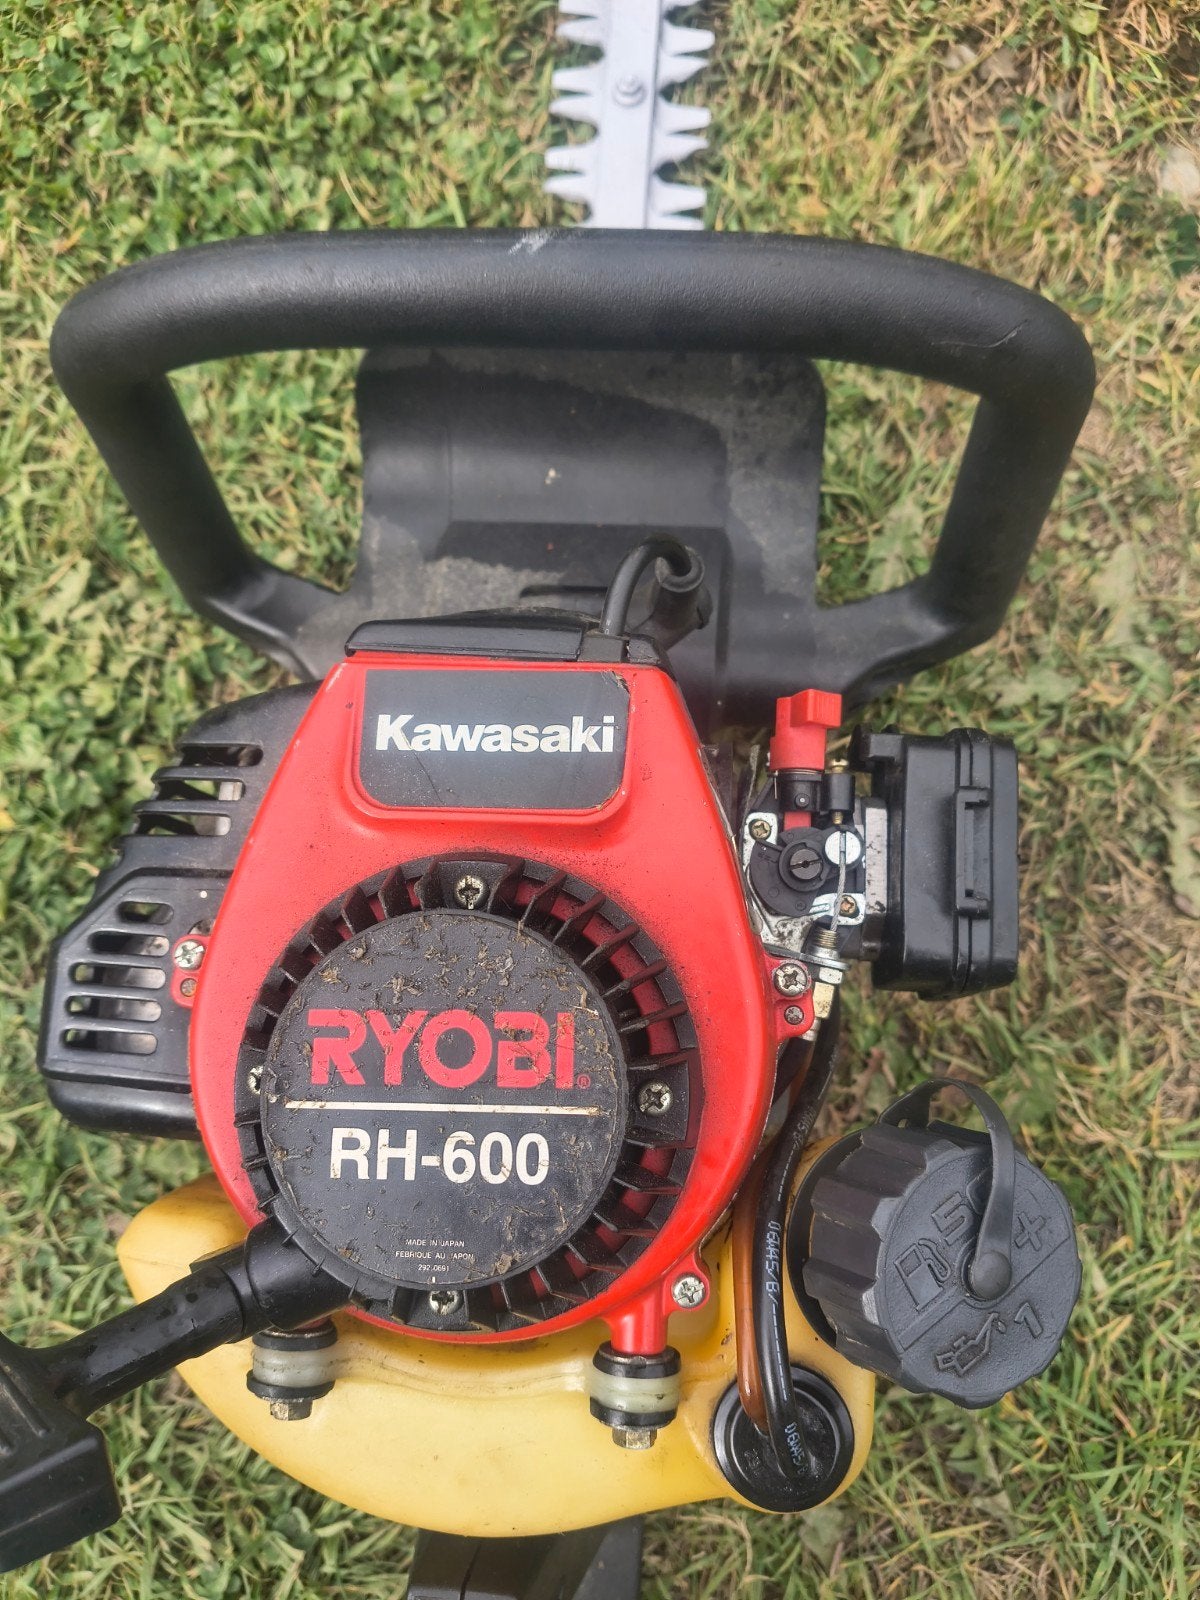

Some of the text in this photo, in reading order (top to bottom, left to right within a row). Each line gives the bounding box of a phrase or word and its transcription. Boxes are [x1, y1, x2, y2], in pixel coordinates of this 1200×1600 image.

[375, 714, 615, 752] Kawasaki
[307, 1008, 575, 1089] RYOBI
[330, 1127, 550, 1186] RH-600
[405, 1239, 465, 1248] MADE IN JAPAN
[1014, 1302, 1044, 1339] 1
